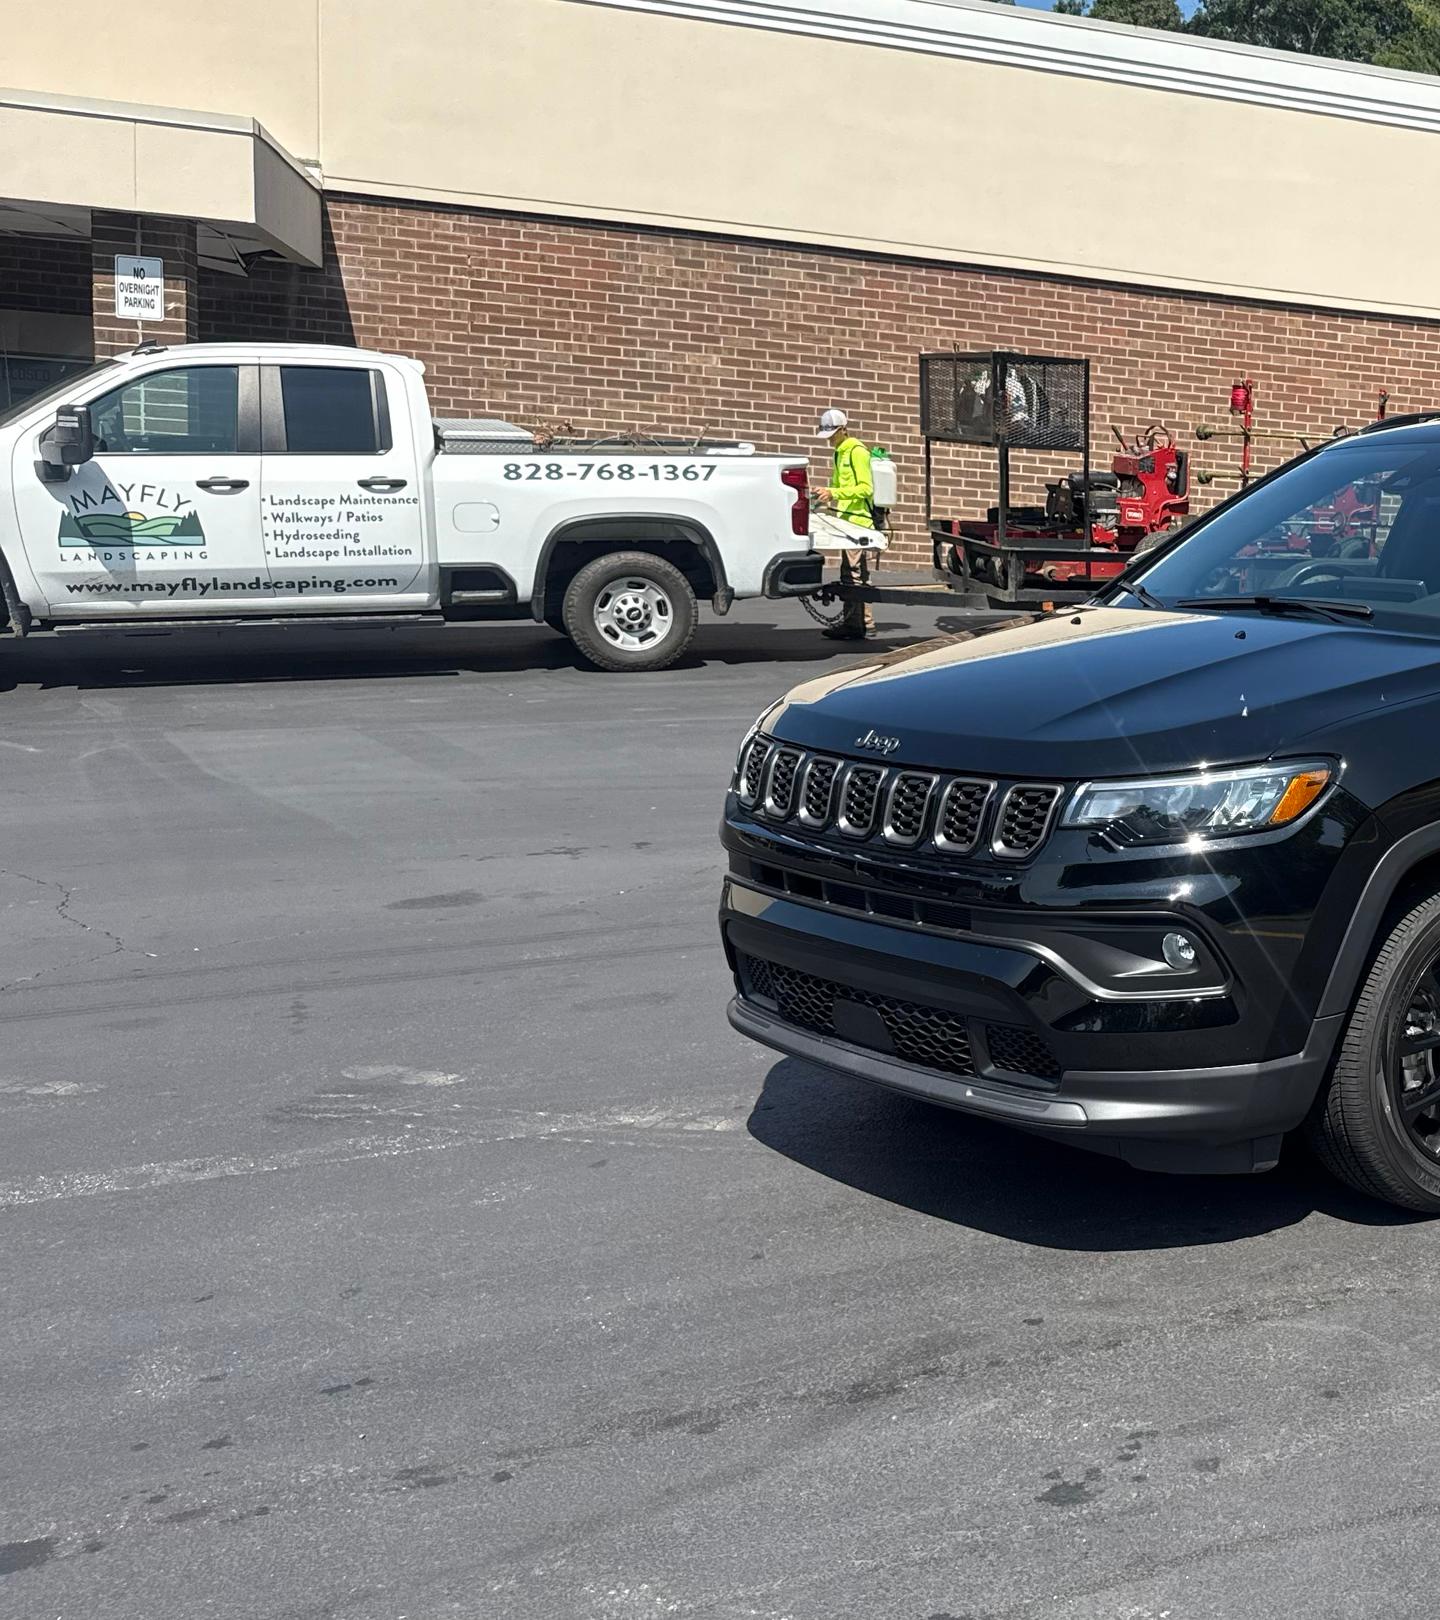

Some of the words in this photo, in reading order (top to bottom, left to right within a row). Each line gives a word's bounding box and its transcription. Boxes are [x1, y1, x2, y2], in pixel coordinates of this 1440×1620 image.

[133, 267, 146, 280] NO
[119, 282, 160, 296] OVERNIGHT
[124, 297, 155, 309] PARKING
[503, 463, 718, 481] 828-768-1367
[69, 483, 192, 514] MAYFLY
[270, 494, 336, 510] Landscape
[339, 493, 419, 505] Maintenance
[270, 511, 334, 527] Walkways
[336, 511, 342, 523] /
[346, 511, 384, 523] Patios
[273, 529, 361, 545] Hydroseeding
[60, 551, 208, 562] LANDSCAPING
[274, 547, 340, 561] Landscape
[343, 545, 412, 557] Installation
[65, 575, 398, 596] www.mayflylandscaping.com
[854, 729, 900, 756] Jeep
